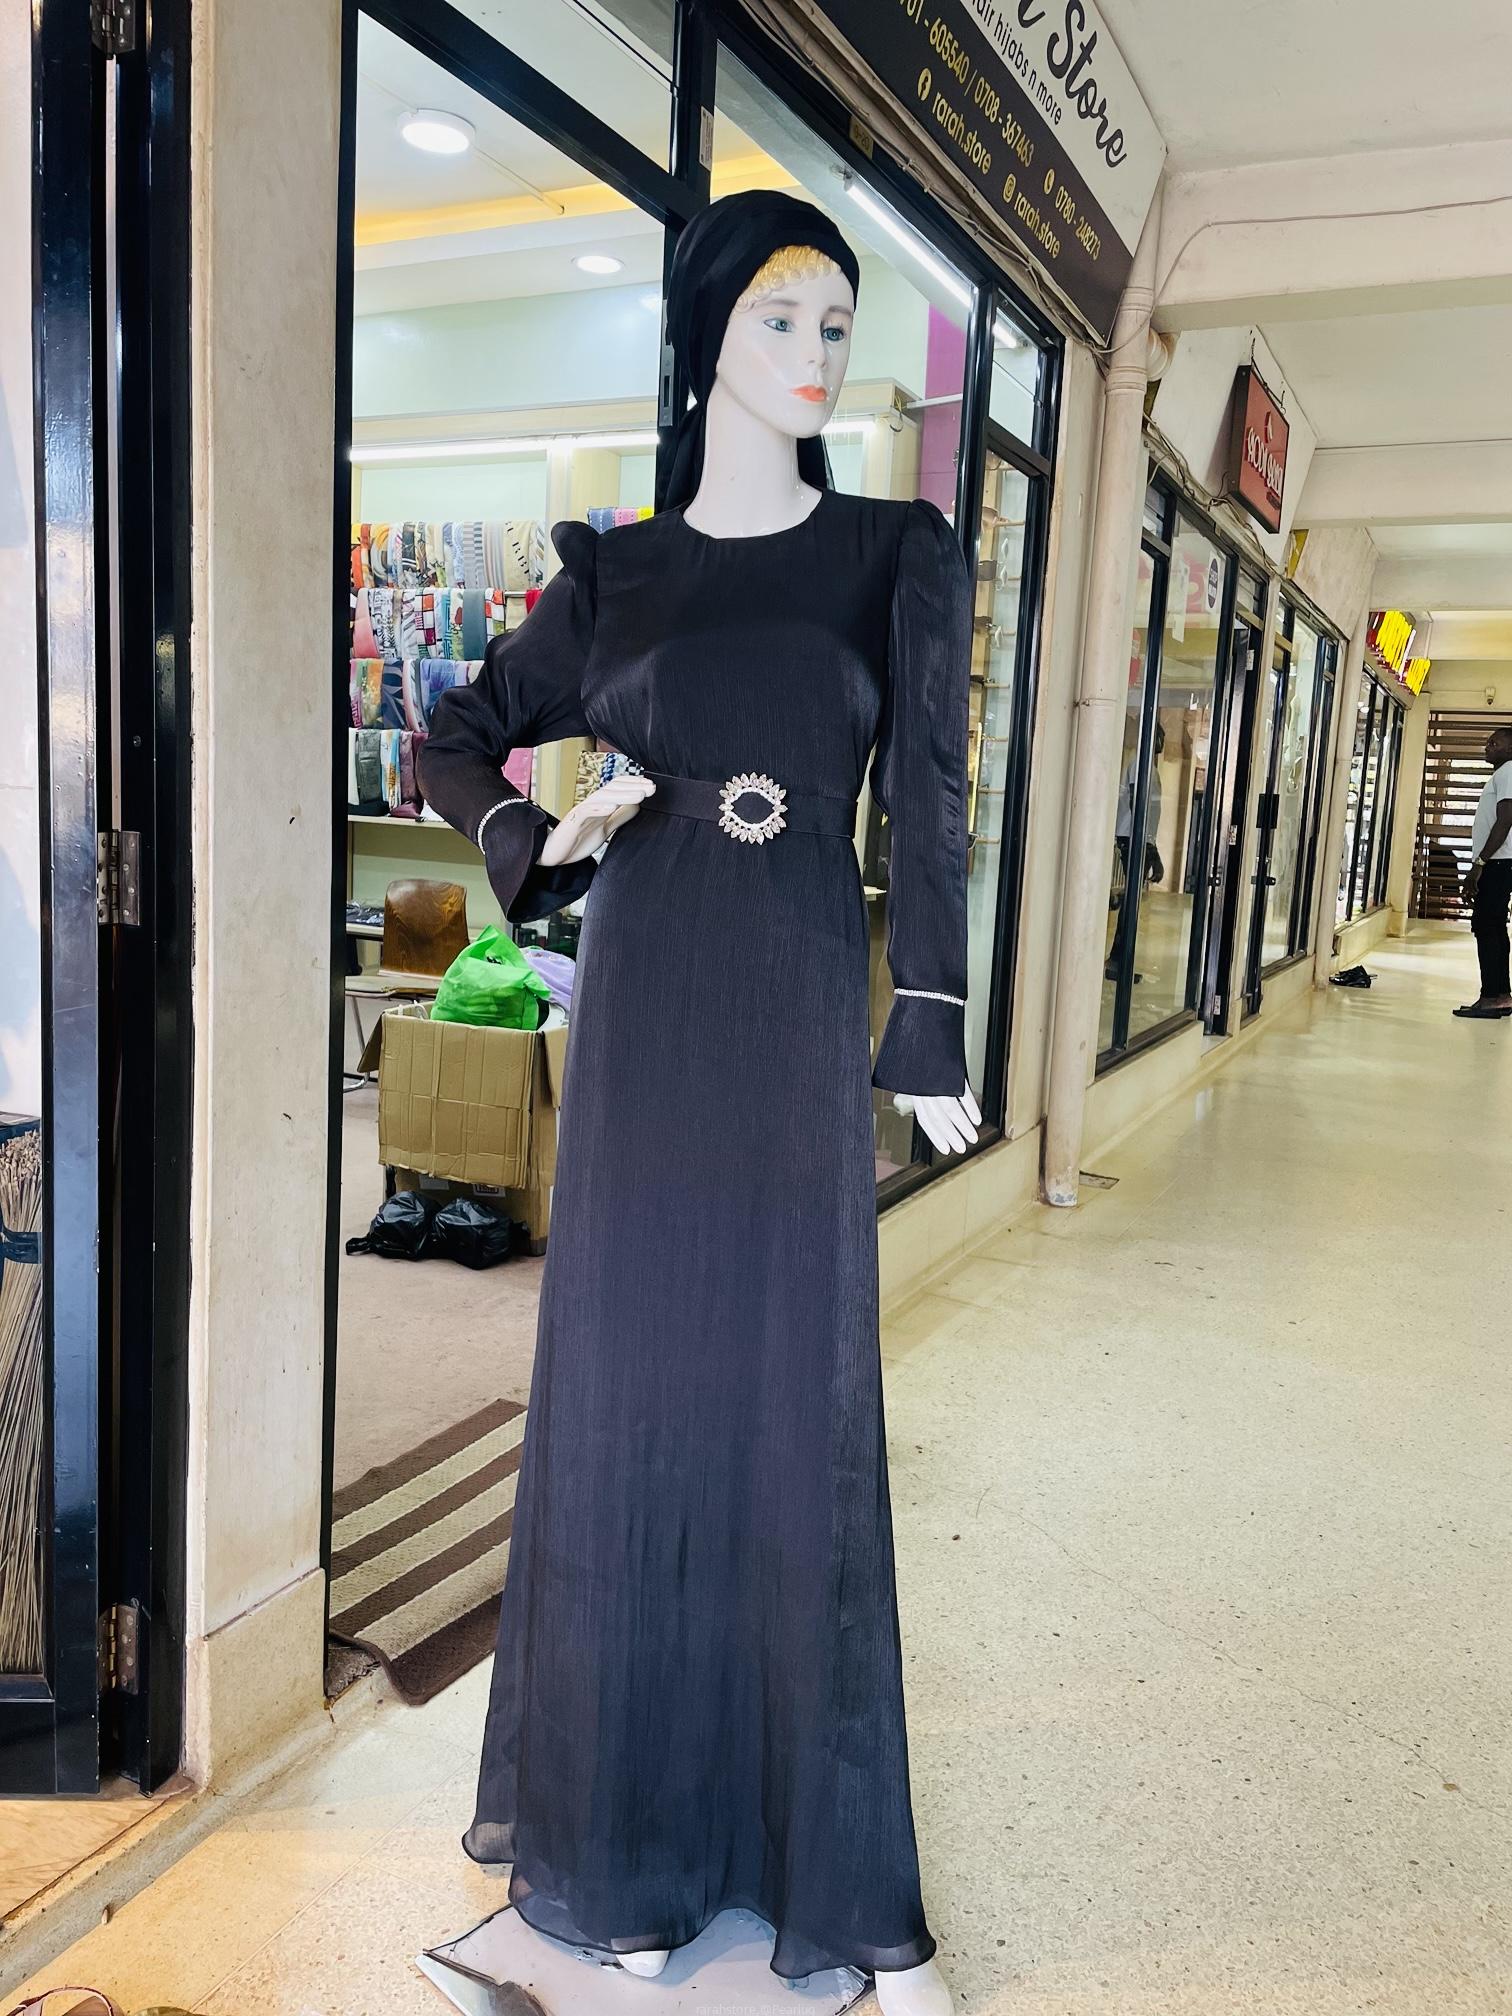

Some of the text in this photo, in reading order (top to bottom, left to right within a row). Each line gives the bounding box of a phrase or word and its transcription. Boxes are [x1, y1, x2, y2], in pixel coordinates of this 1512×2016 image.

[899, 0, 924, 24] 01
[929, 17, 970, 84] 605540
[964, 69, 978, 97] /
[975, 76, 1000, 123] 0708
[1002, 112, 1035, 168] 367463
[972, 0, 1062, 126] air hijabs n more
[1046, 0, 1128, 168] Store
[932, 92, 992, 175] rarah.store
[1013, 191, 1061, 258] rarah.store
[1054, 186, 1076, 224] 0780
[1075, 215, 1101, 261] 248273
